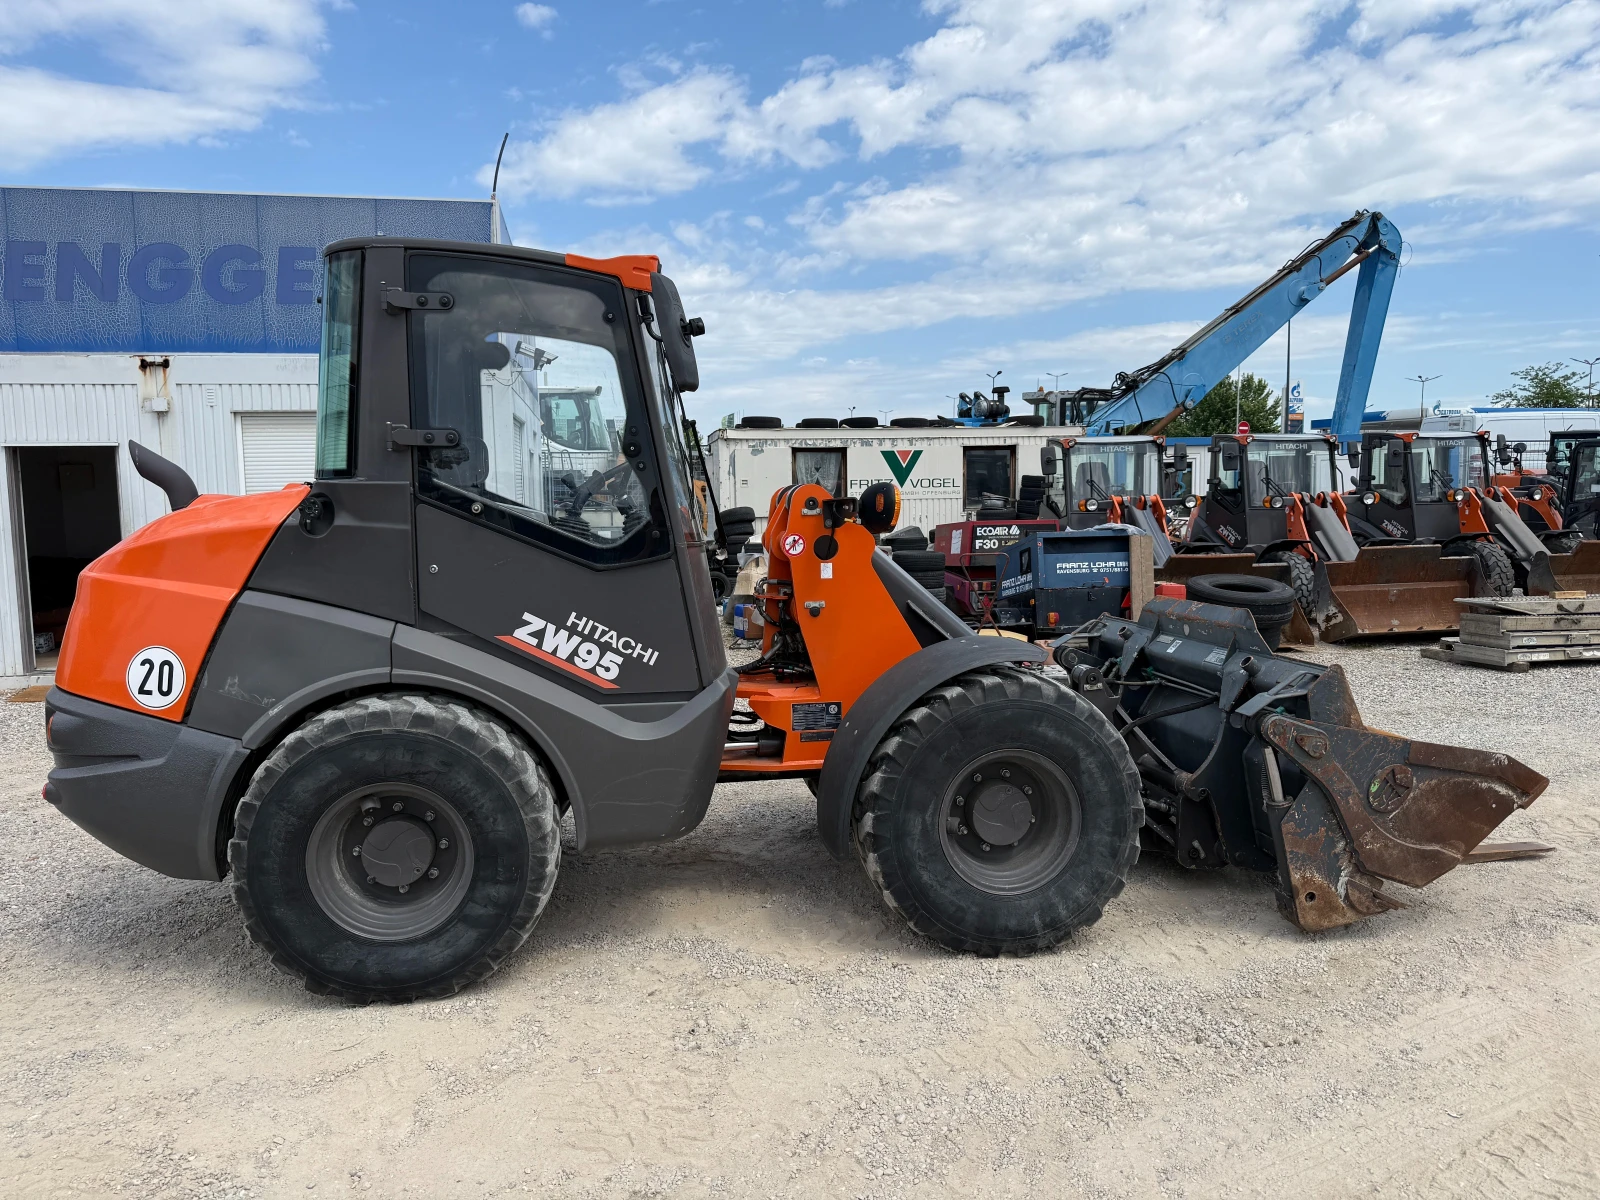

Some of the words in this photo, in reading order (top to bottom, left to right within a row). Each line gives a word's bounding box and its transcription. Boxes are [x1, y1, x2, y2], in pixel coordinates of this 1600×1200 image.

[1100, 445, 1134, 453] HITACHI
[909, 478, 961, 489] VOGEL
[976, 526, 1009, 536] ECOAIR
[1218, 524, 1236, 544] ZW75
[1382, 519, 1402, 538] ZW95
[1391, 520, 1409, 535] HITACHI
[975, 539, 999, 550] F30
[512, 611, 625, 681] ZW95
[566, 611, 659, 666] HITACHI
[138, 658, 174, 697] 20
